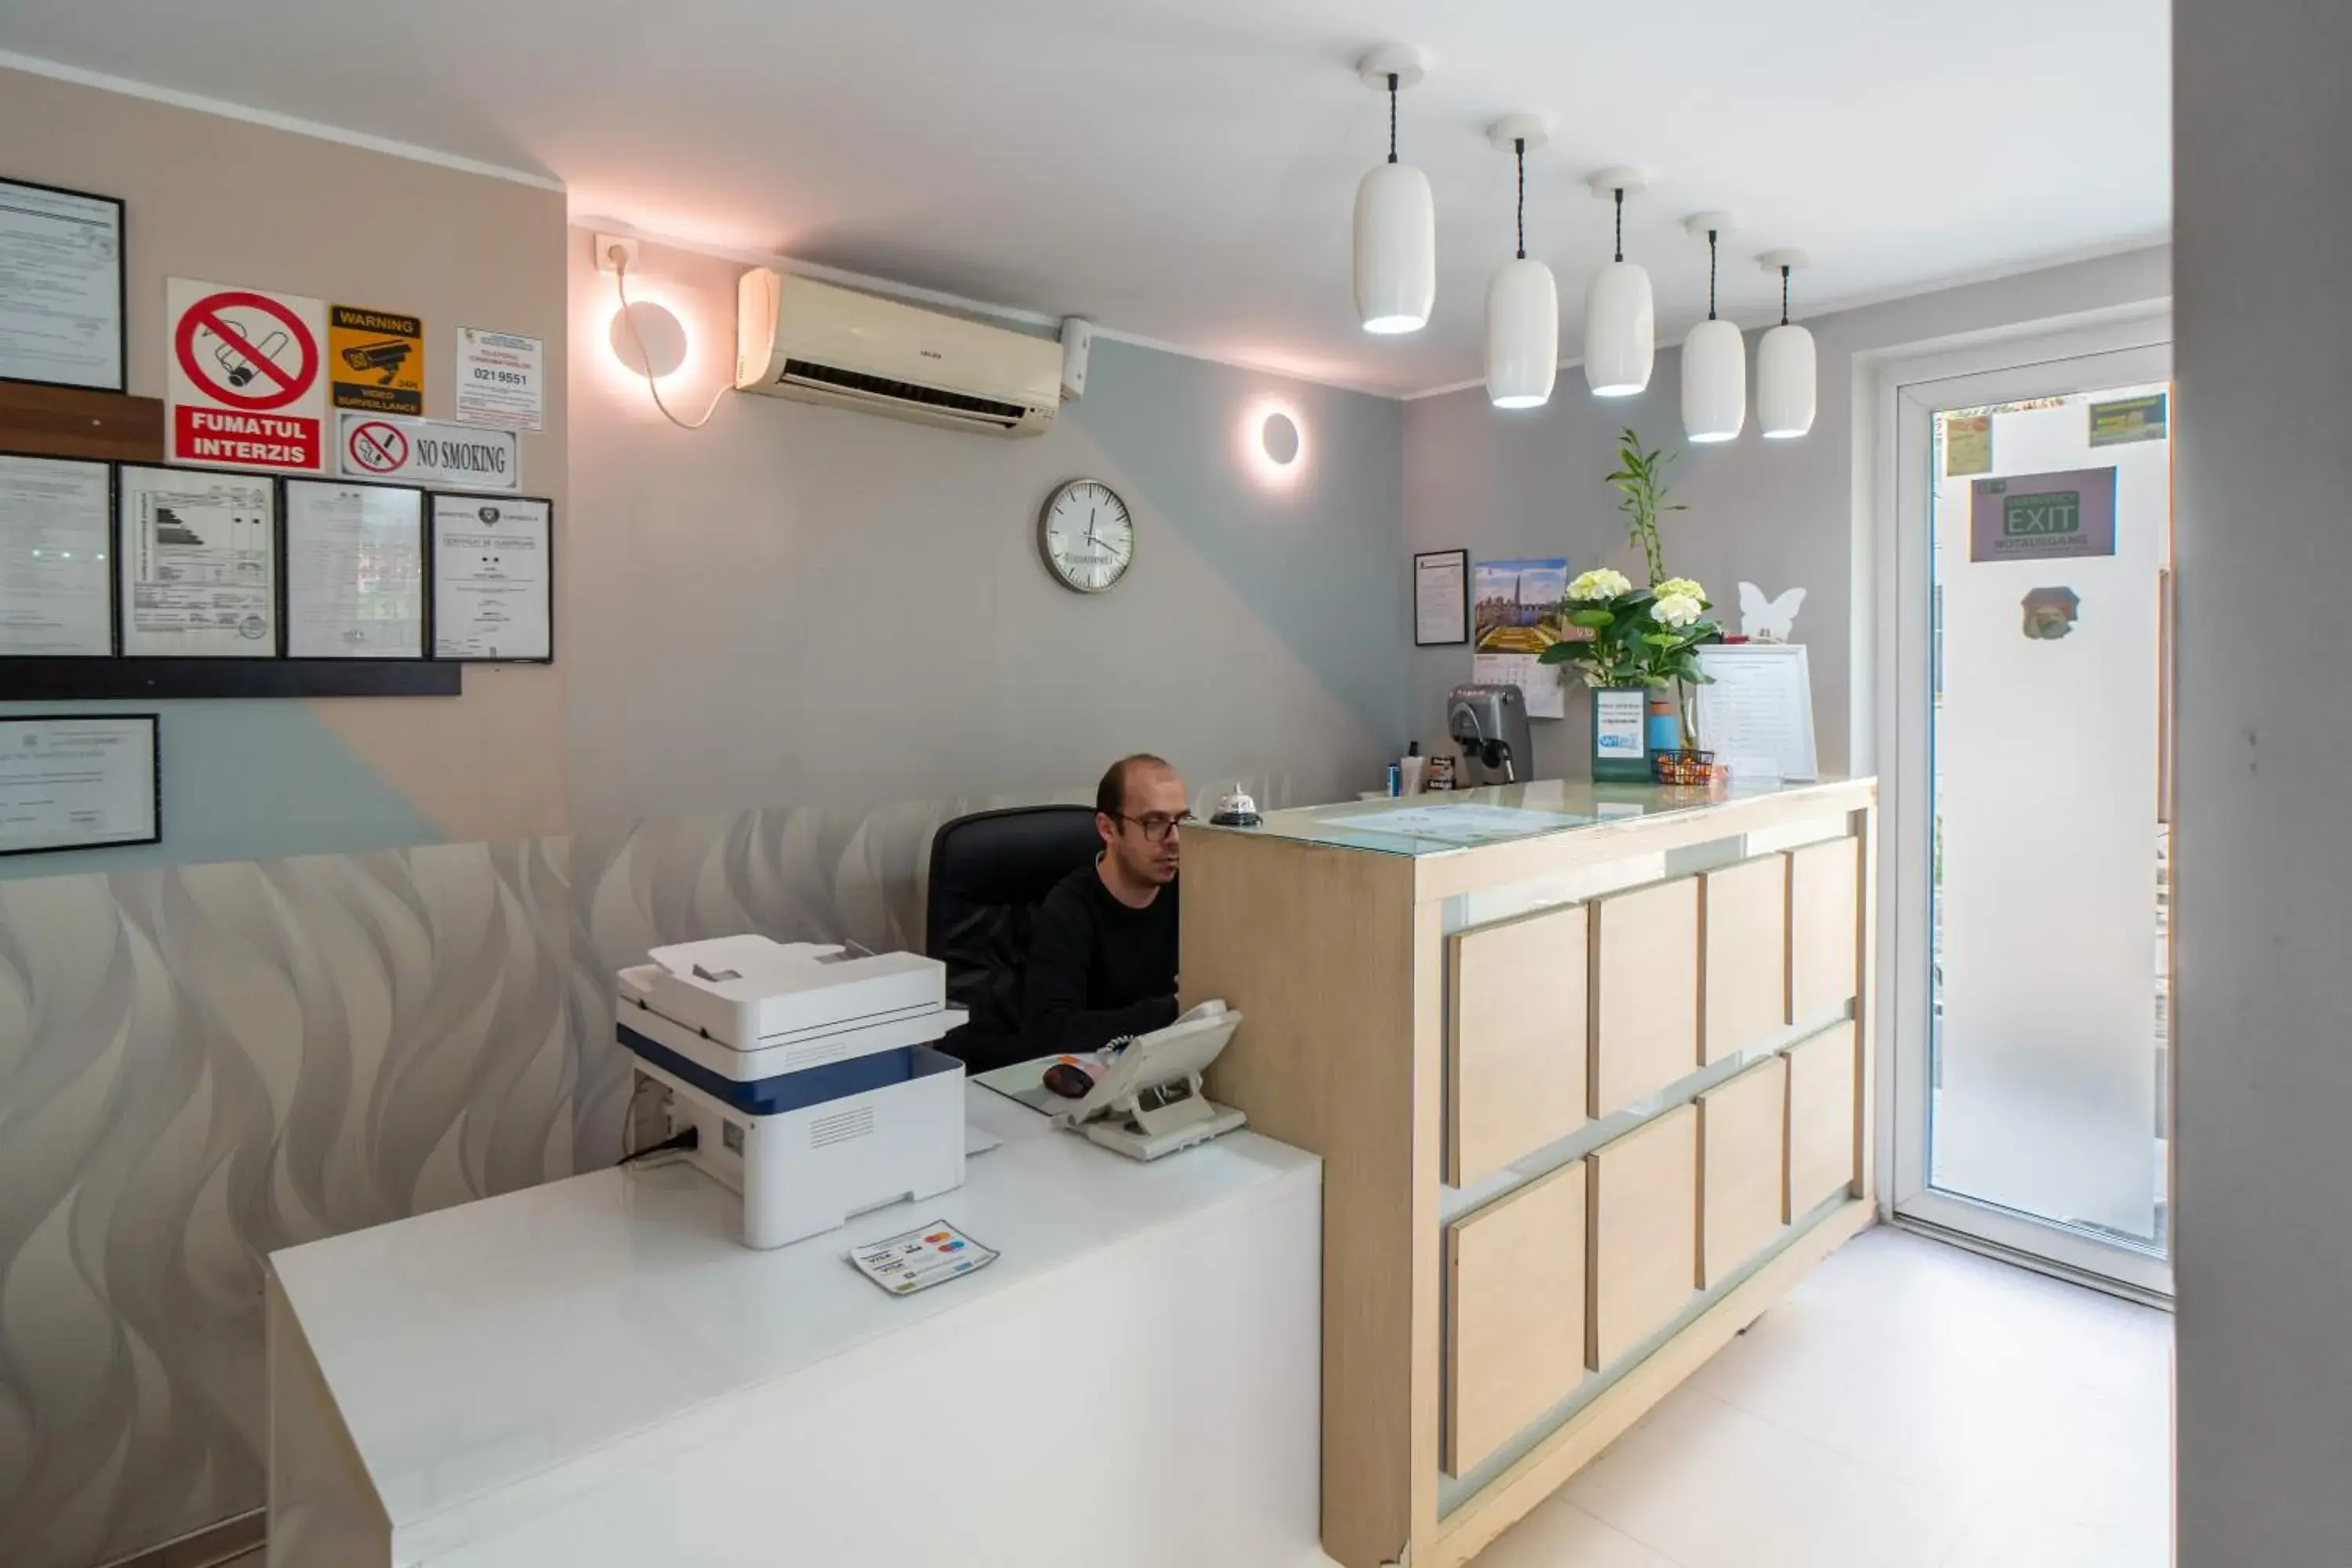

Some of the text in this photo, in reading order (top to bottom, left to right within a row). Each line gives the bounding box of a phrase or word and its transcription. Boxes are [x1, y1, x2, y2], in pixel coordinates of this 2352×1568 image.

[339, 310, 414, 333] WARNING
[192, 412, 307, 440] FUMATUL
[194, 440, 306, 463] INTERZIS
[416, 440, 506, 474] NO SMOKING
[2008, 505, 2077, 534] EXIT
